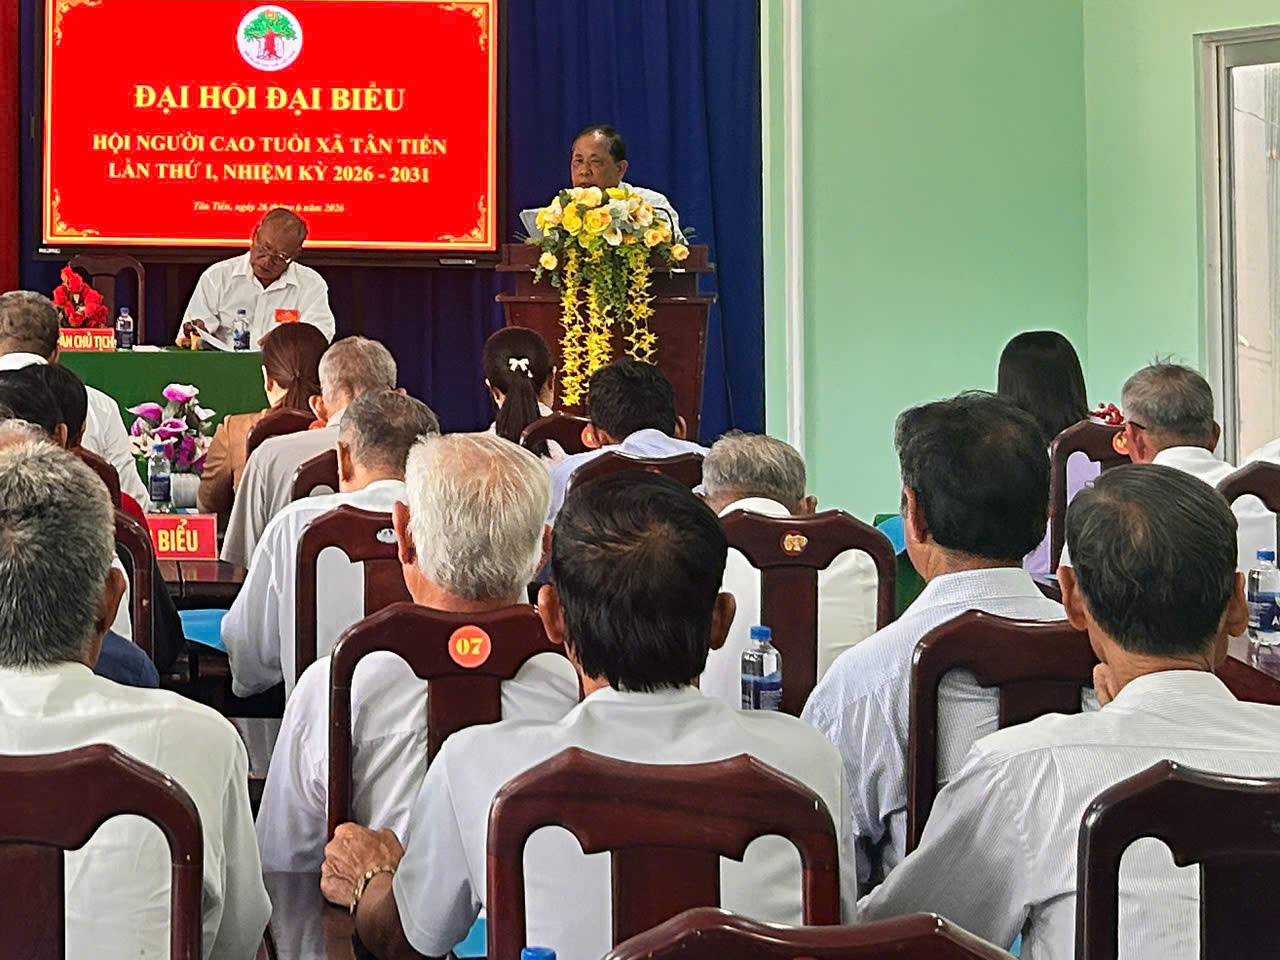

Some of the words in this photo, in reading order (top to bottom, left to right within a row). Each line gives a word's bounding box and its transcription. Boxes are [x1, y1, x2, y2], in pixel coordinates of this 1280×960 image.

[133, 83, 190, 115] ĐẠI
[199, 82, 257, 115] HỘI
[265, 86, 323, 116] ĐẠI
[330, 79, 406, 112] BIỂU
[92, 131, 131, 154] HỘI
[136, 131, 205, 152] NGƯỜI
[209, 135, 256, 152] CAO
[315, 134, 345, 154] XÃ
[349, 133, 393, 155] TÂN
[155, 159, 202, 180] THỨ
[223, 162, 293, 185] NHIỆM
[332, 165, 375, 182] 2026
[390, 166, 430, 183] 2031
[73, 331, 93, 349] CHỦ
[157, 518, 200, 552] BIỂU
[455, 637, 483, 656] 07
